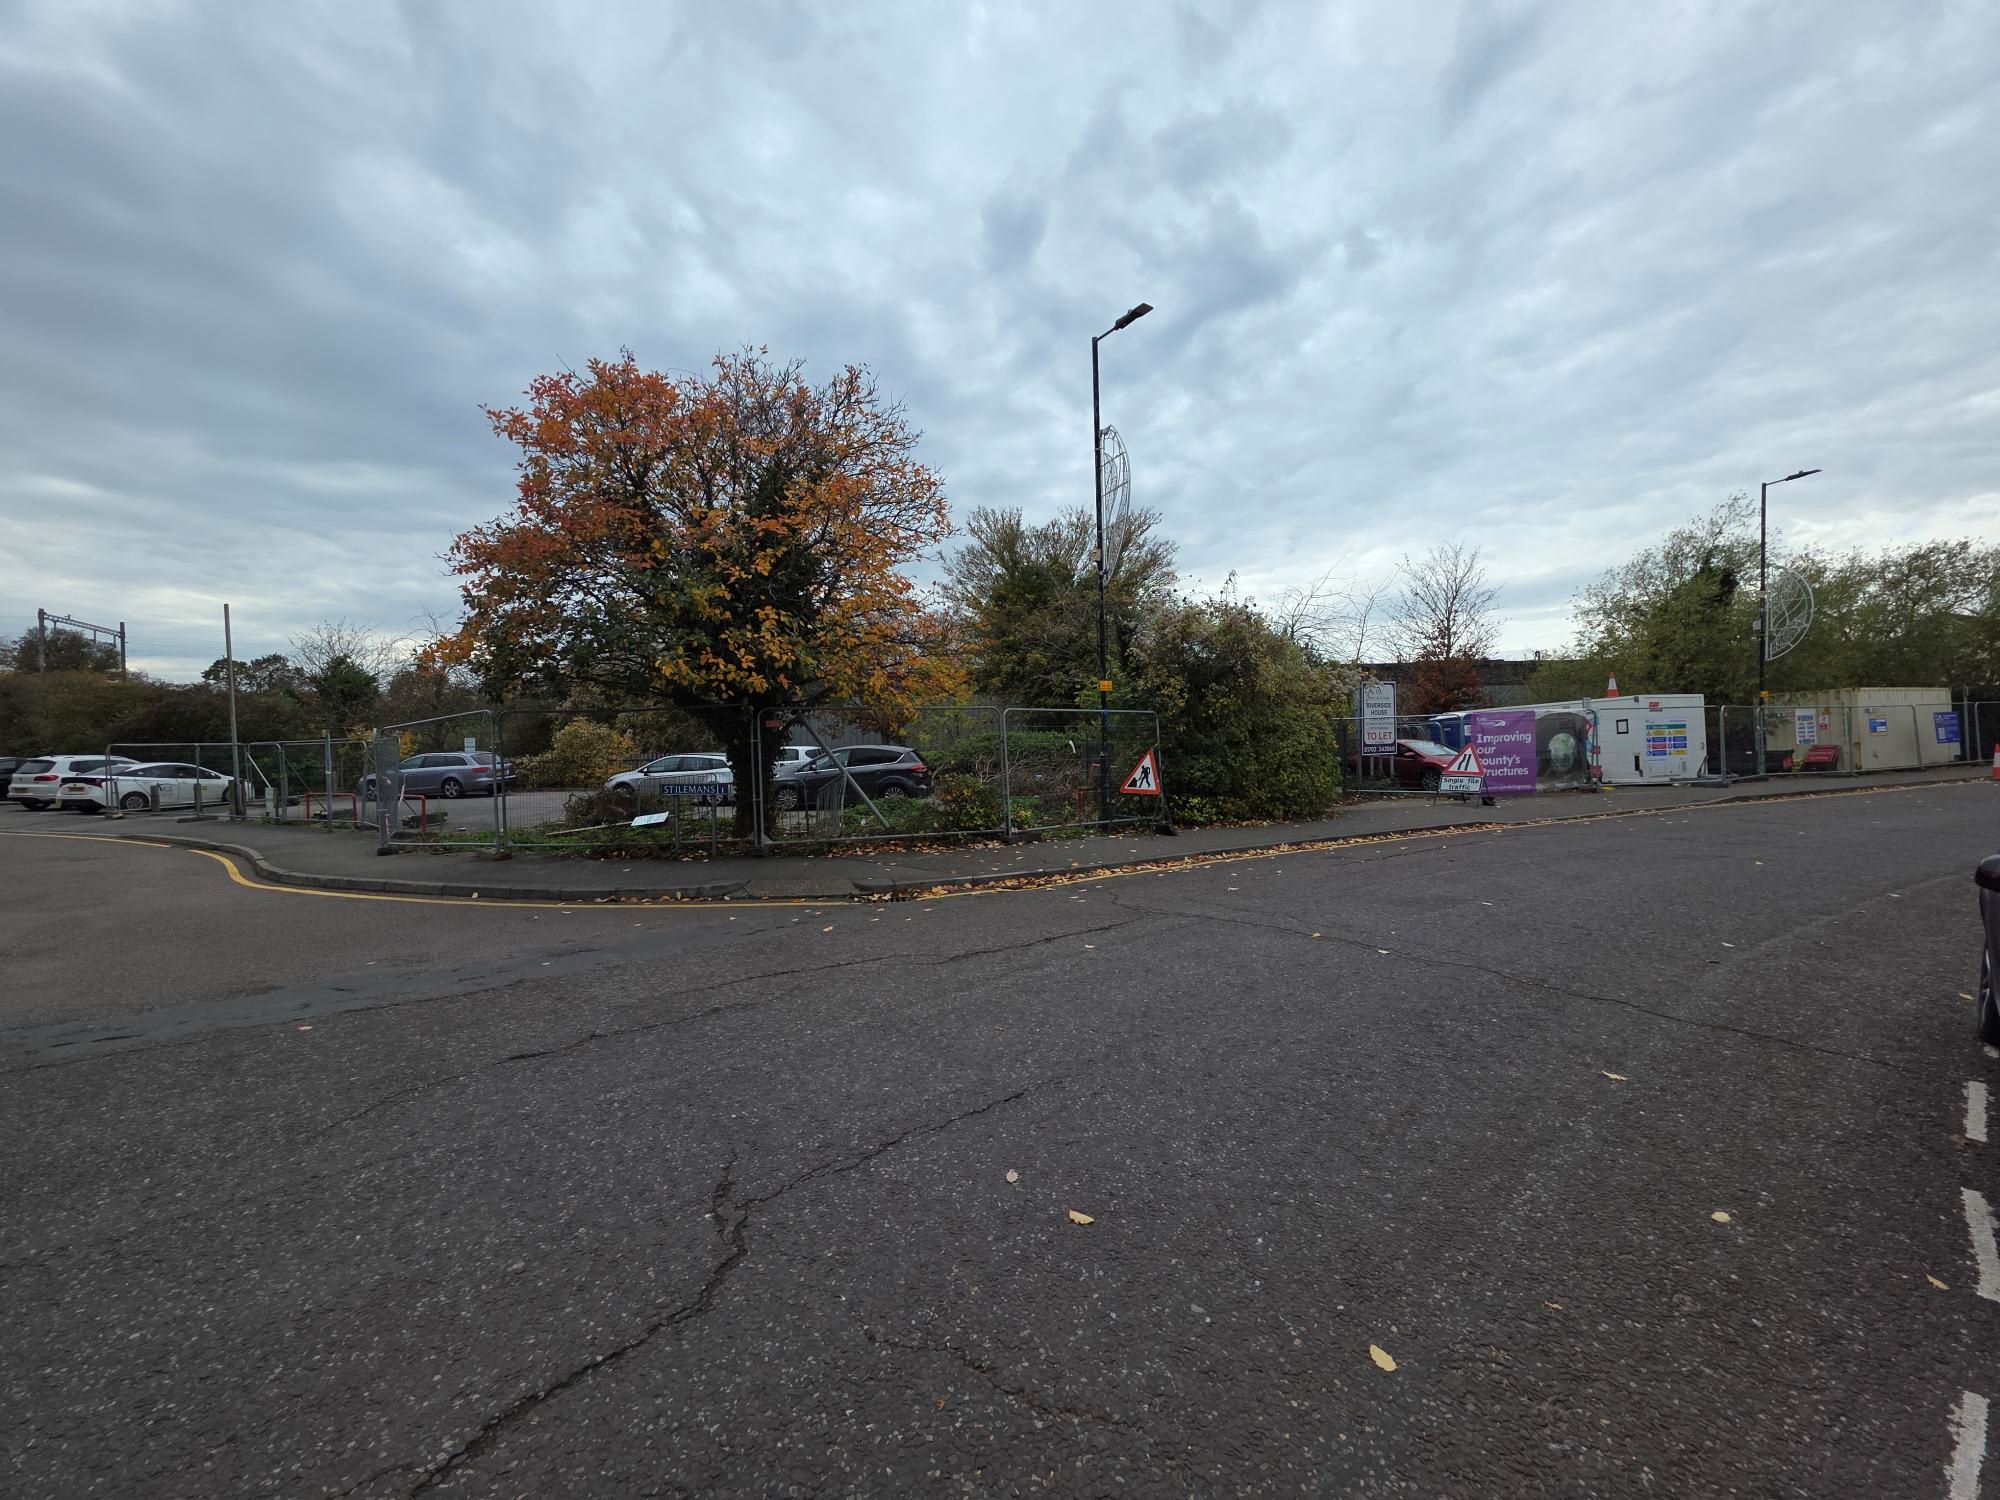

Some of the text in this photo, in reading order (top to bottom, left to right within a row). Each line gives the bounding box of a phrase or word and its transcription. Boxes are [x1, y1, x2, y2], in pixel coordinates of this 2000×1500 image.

[1366, 731, 1393, 741] TO LET
[1476, 731, 1532, 745] Improving
[1476, 746, 1497, 755] our
[663, 785, 716, 794] STILEMANS
